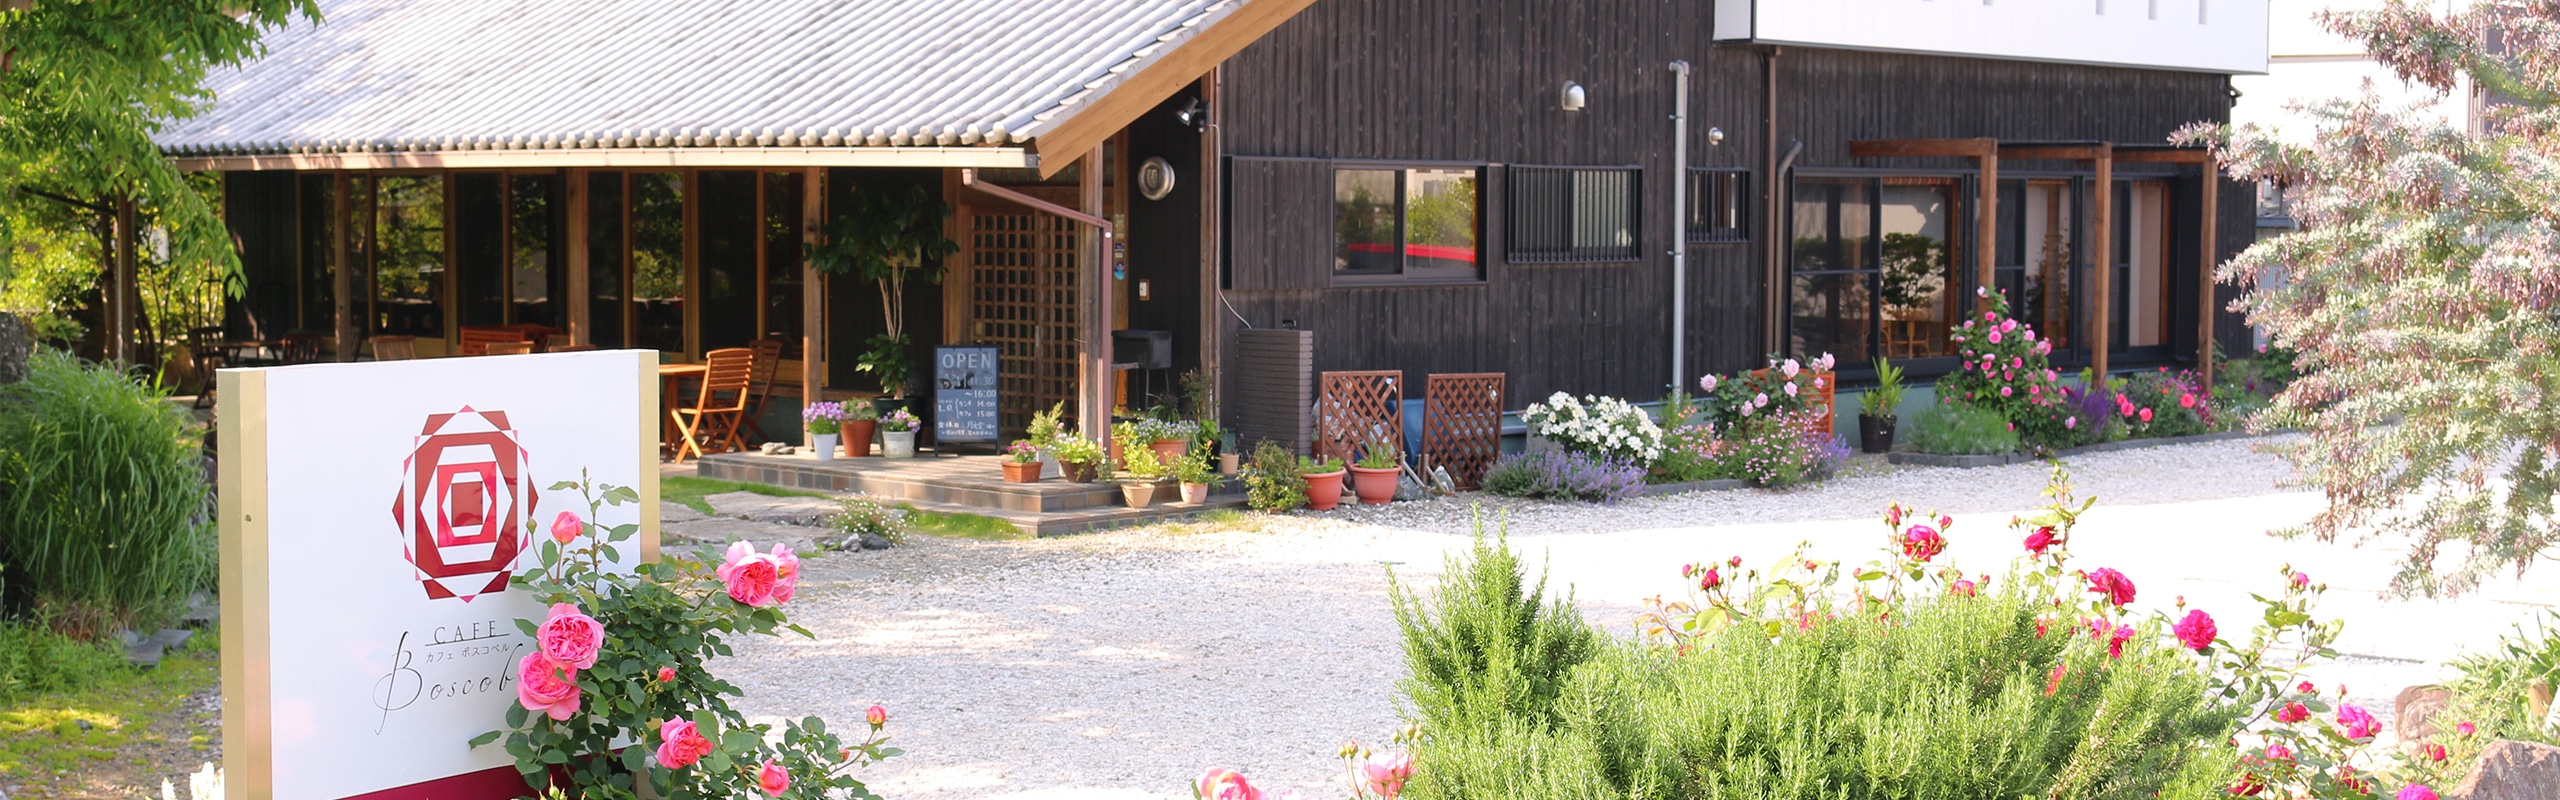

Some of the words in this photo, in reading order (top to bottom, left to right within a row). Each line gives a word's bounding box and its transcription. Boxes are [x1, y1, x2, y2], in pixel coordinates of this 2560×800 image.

[942, 353, 991, 369] OPEN
[434, 620, 496, 645] CAFE
[425, 651, 454, 664] カフェ
